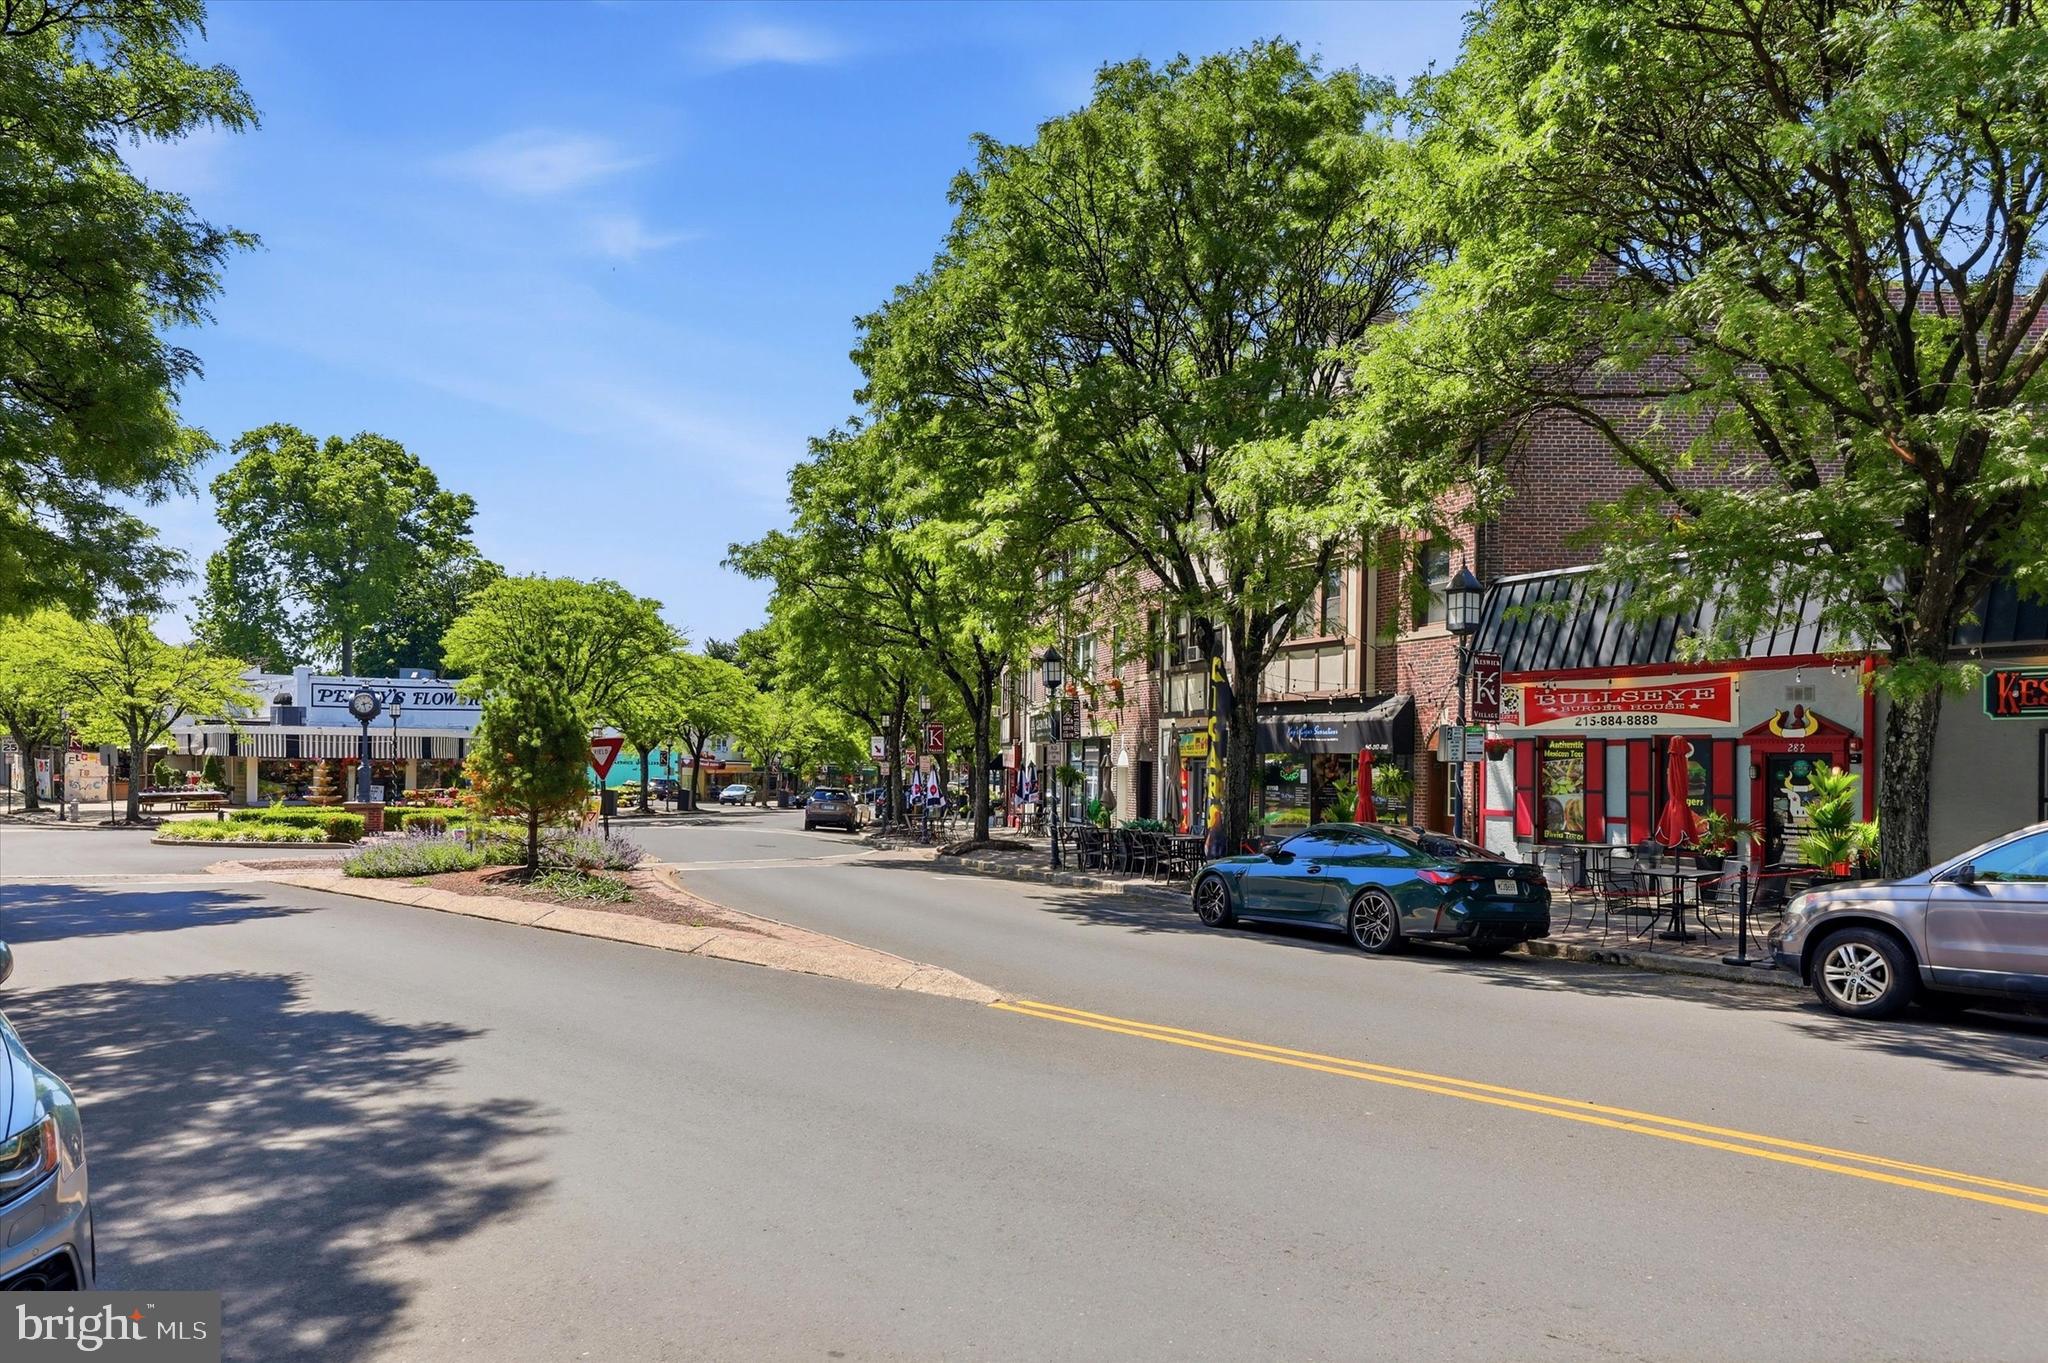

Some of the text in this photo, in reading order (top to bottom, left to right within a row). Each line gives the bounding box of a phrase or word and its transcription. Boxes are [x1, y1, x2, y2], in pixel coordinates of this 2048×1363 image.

[1474, 656, 1500, 666] KESWICK
[1474, 671, 1499, 705] K
[318, 688, 406, 704] PEY'S
[1534, 687, 1716, 706] BULLSEYE
[1561, 702, 1686, 713] BURGER HOUSE
[1473, 710, 1499, 719] VILLAGE
[1574, 714, 1659, 727] 215-884-8888
[930, 730, 942, 746] K
[1549, 740, 1584, 750] Authentic
[1787, 743, 1806, 753] 282
